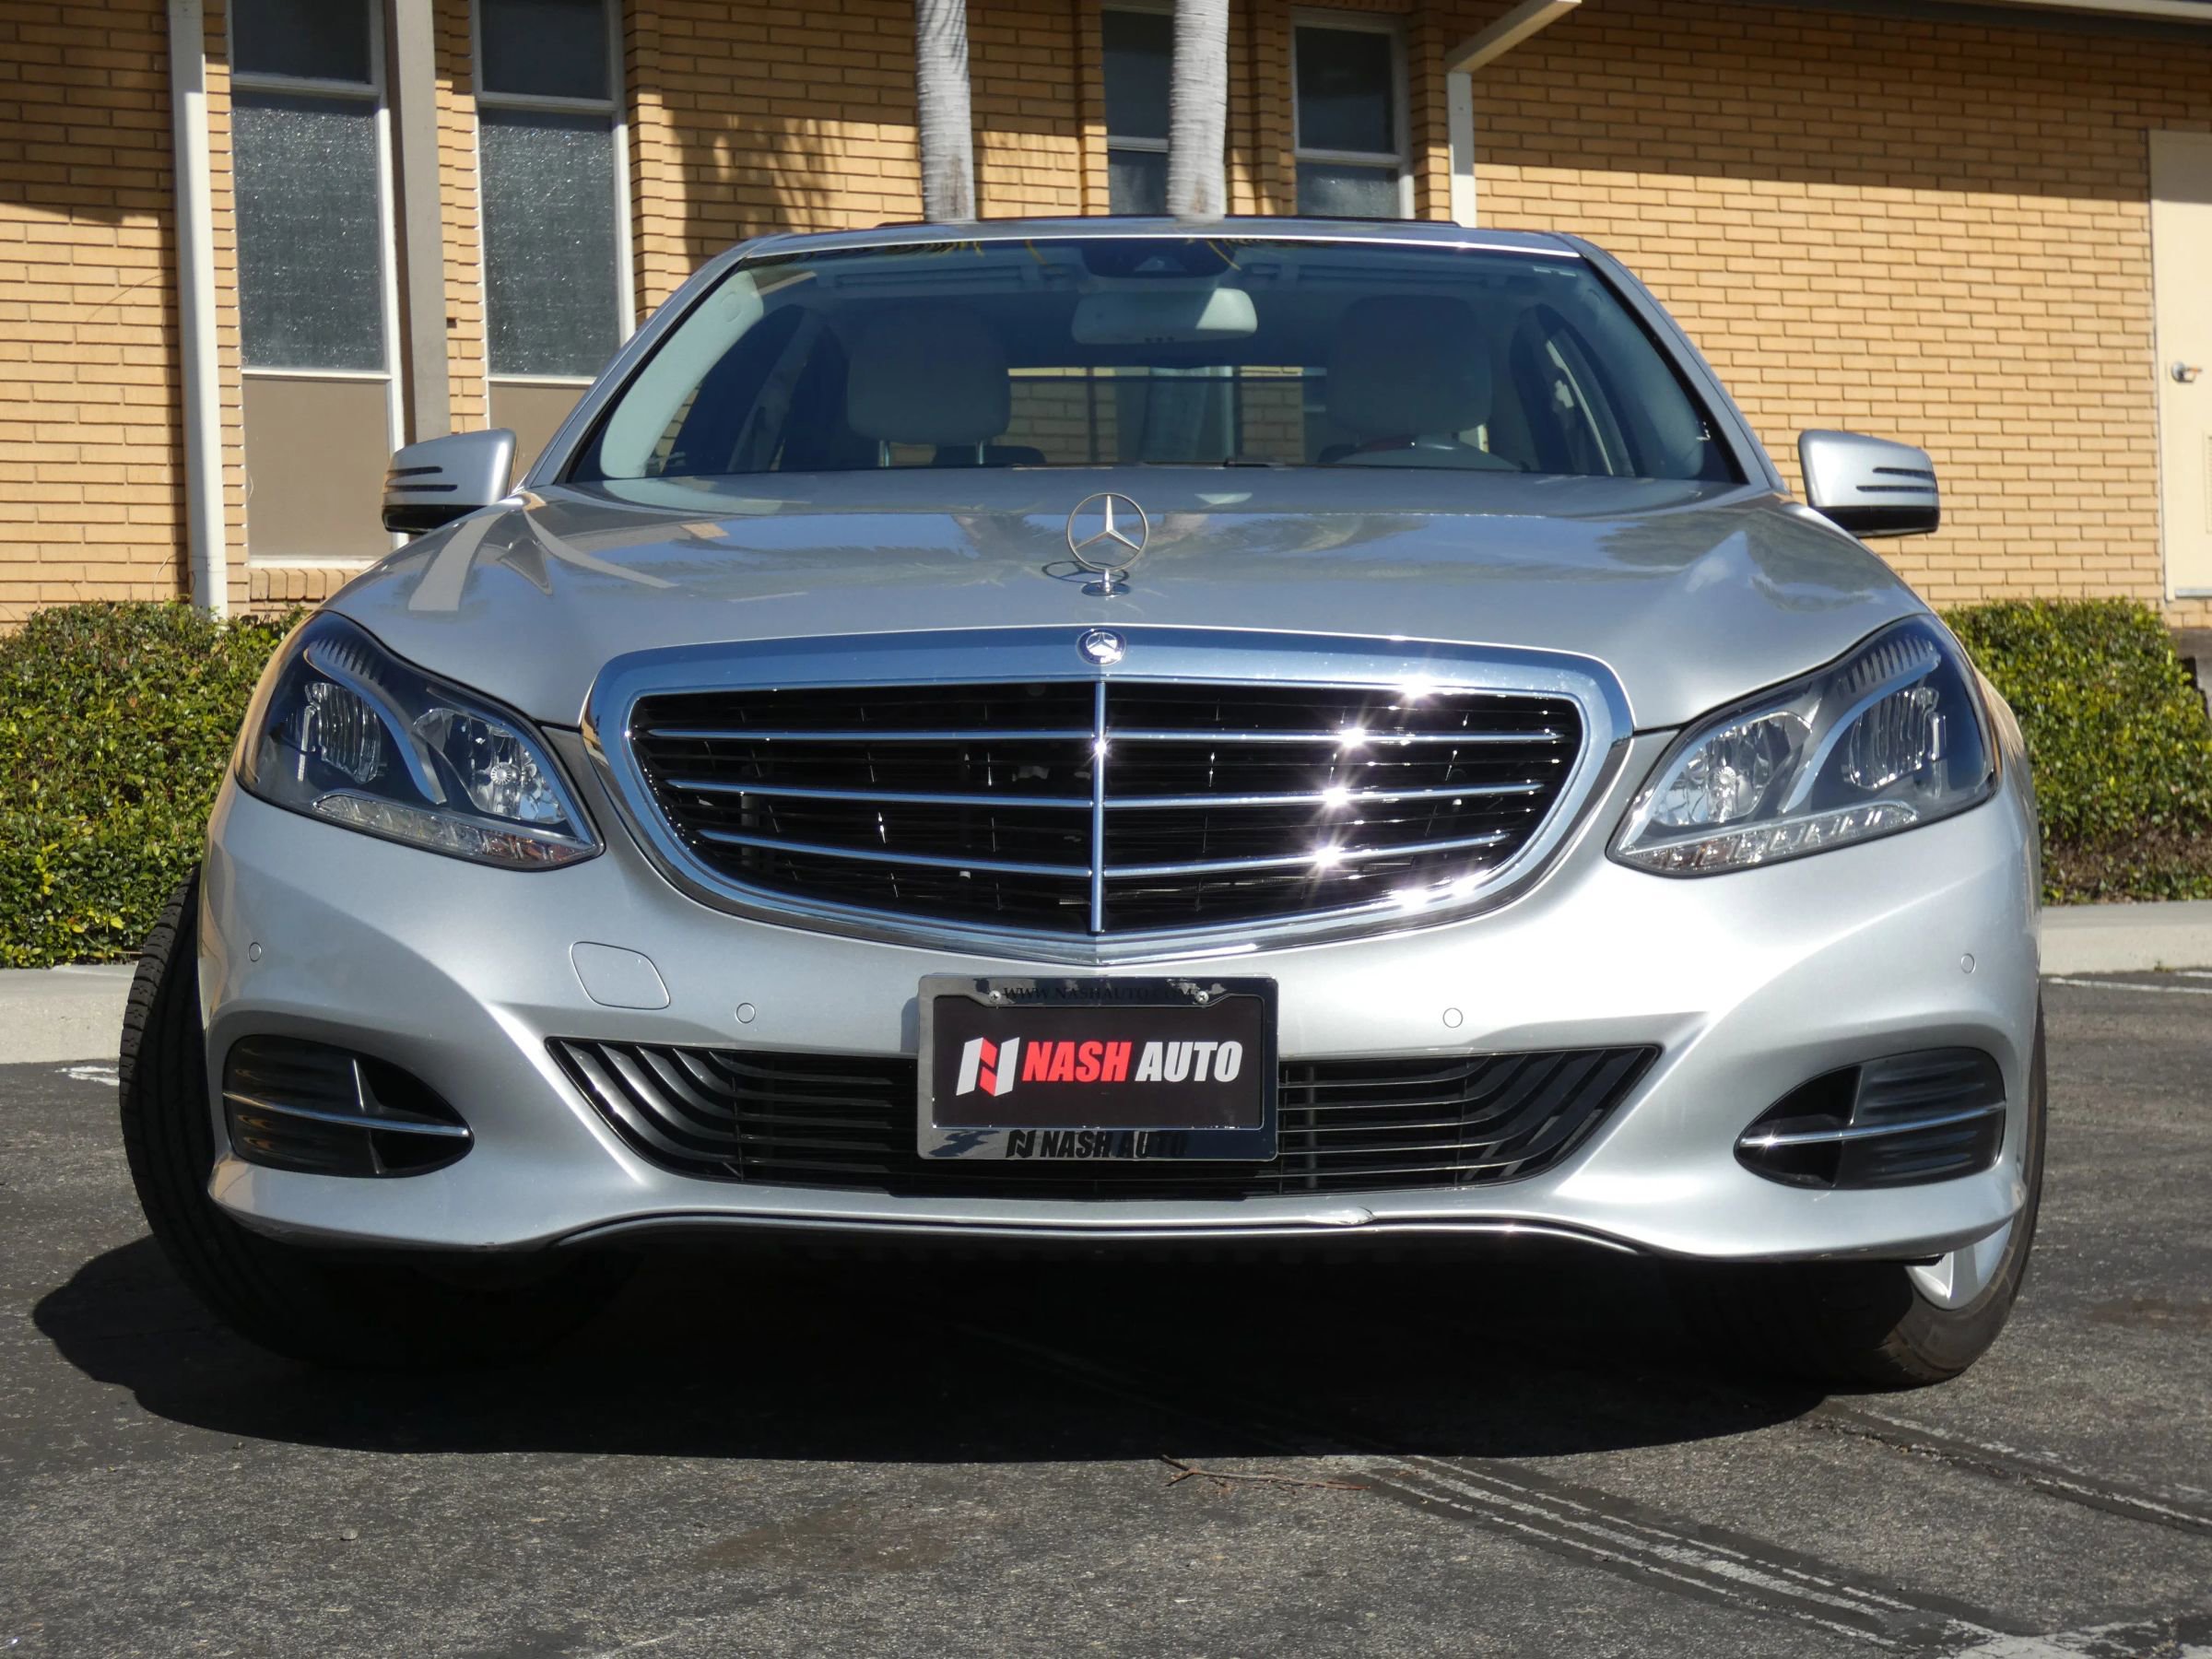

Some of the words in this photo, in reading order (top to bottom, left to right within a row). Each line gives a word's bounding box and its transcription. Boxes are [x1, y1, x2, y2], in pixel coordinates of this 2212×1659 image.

[1022, 1041, 1133, 1082] NASH
[1135, 1041, 1243, 1083] AUTO
[1040, 1130, 1113, 1159] NASH
